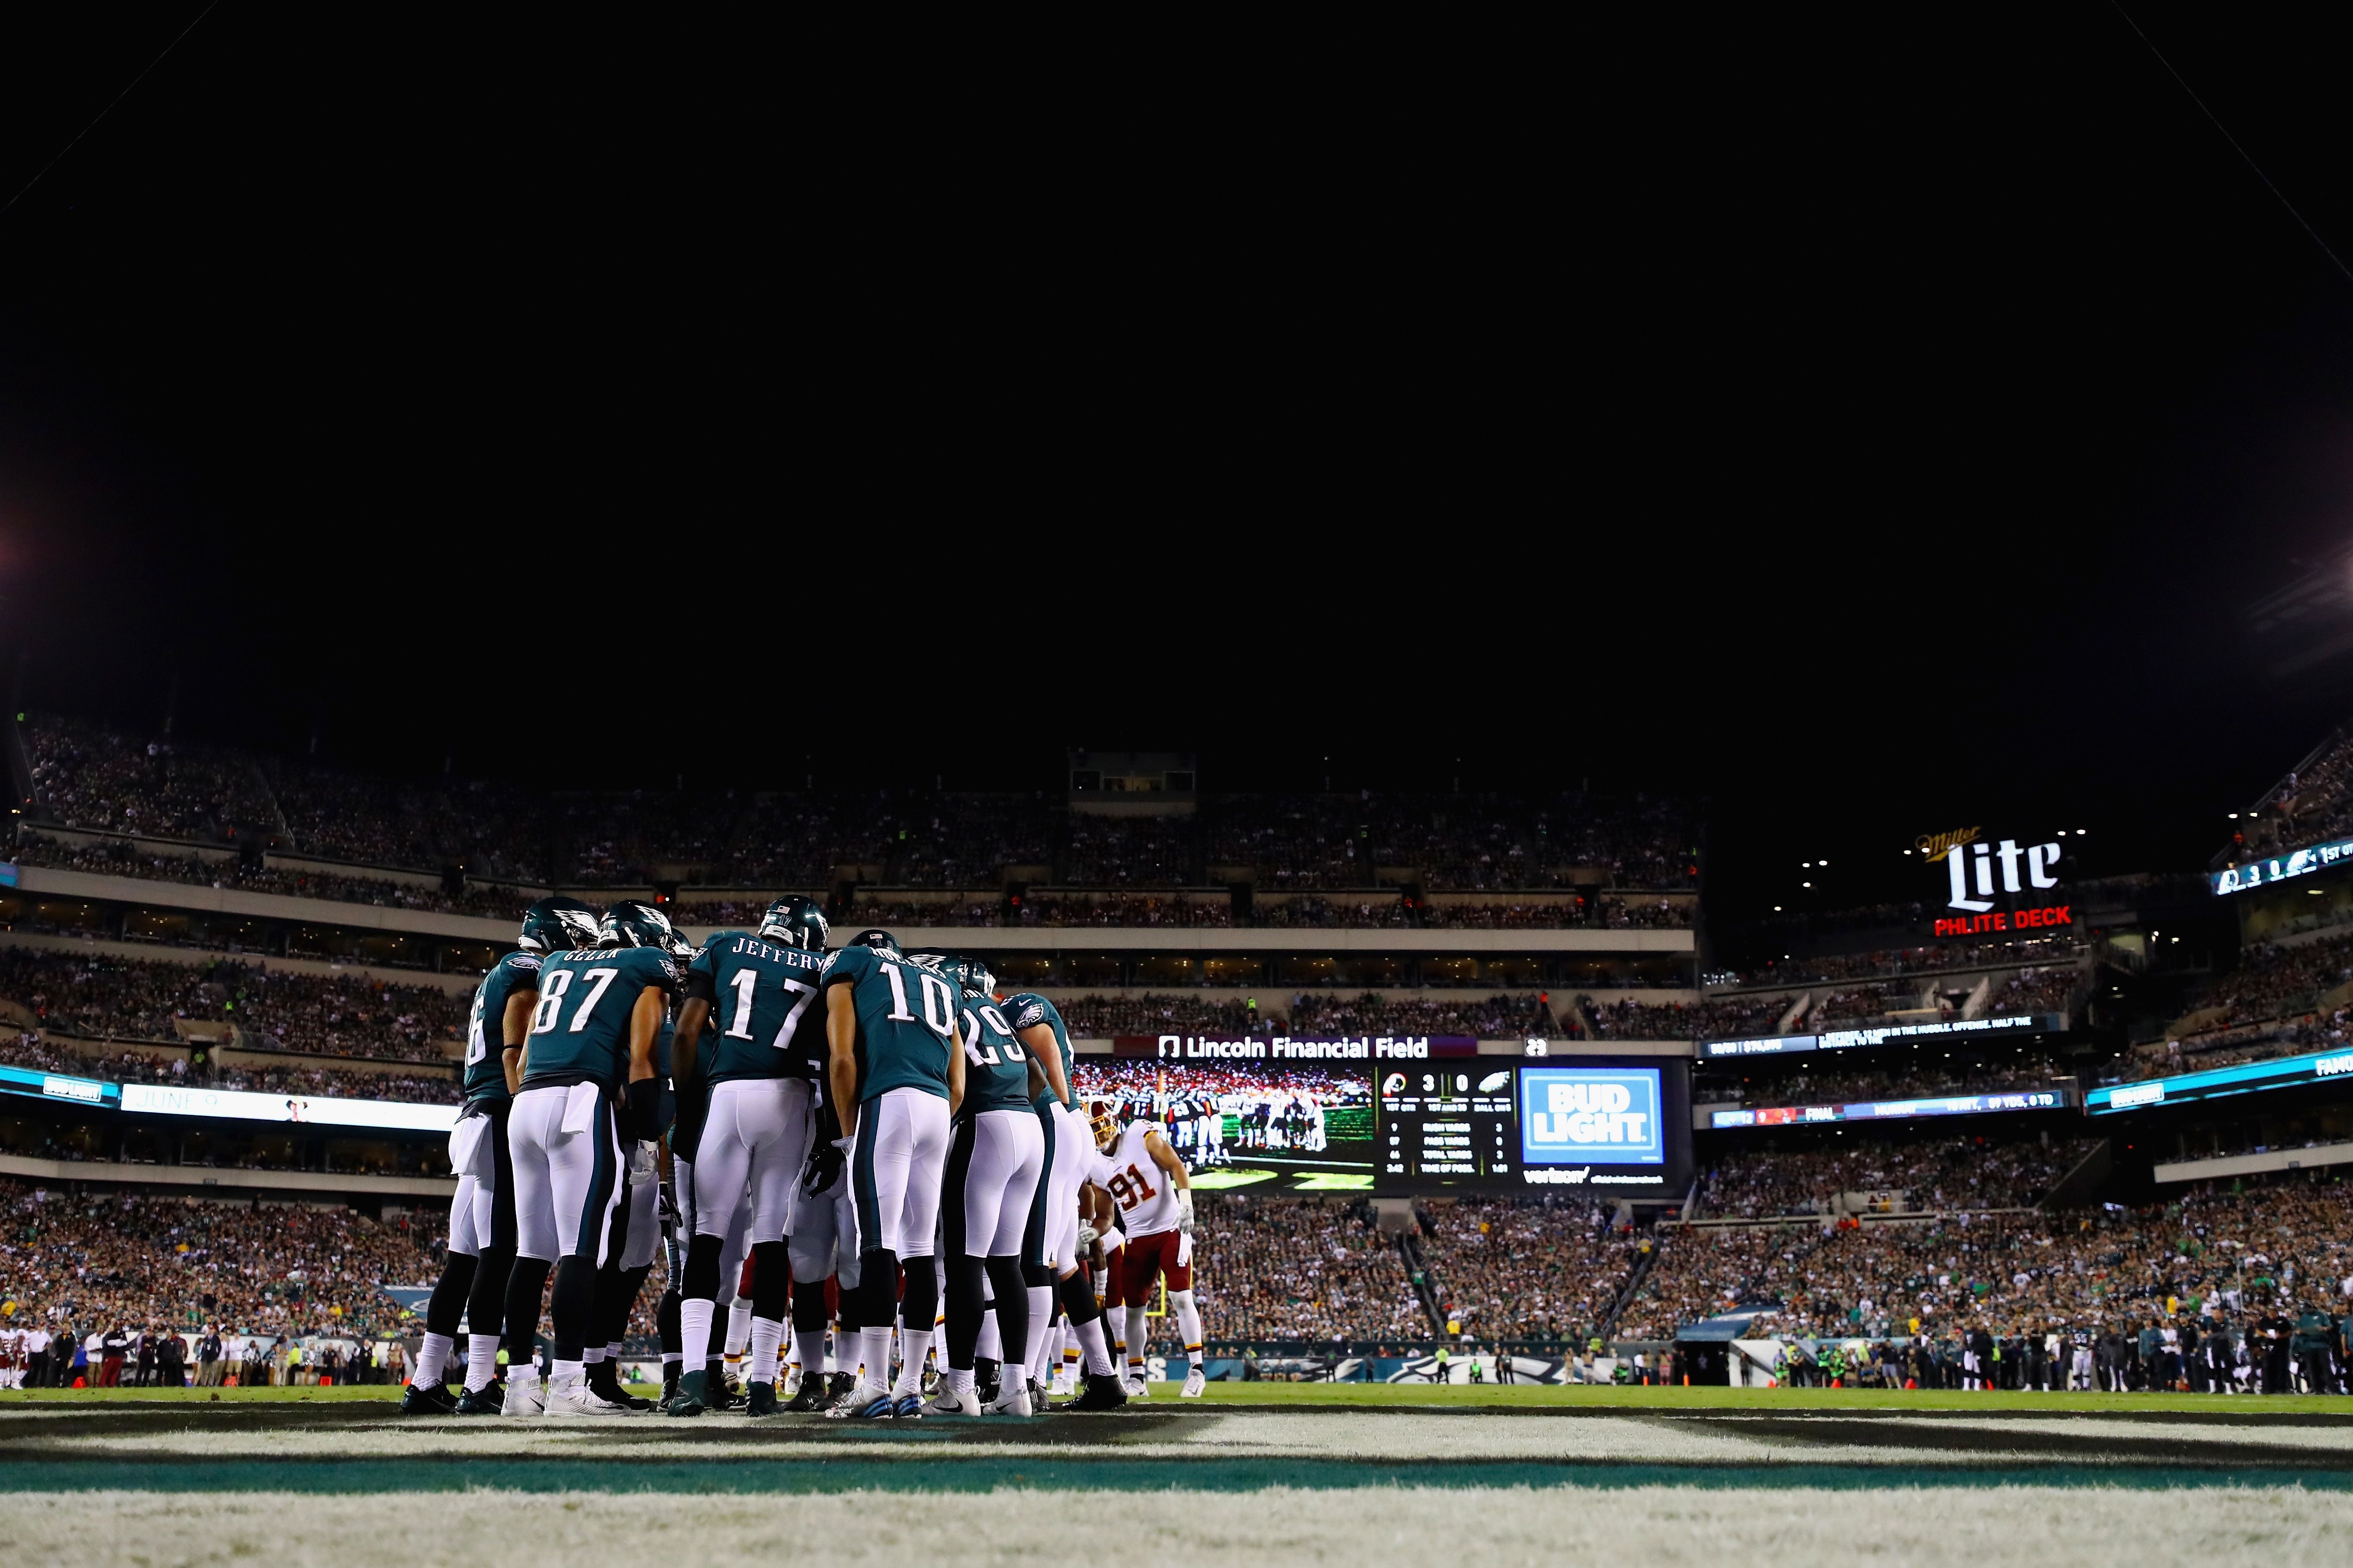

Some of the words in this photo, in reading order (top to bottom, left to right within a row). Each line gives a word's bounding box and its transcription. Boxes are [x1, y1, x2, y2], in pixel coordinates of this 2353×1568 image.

[2320, 847, 2340, 864] 1ST
[1948, 839, 2061, 912] Lite
[2251, 866, 2260, 881] 3
[778, 914, 792, 927] 17
[1934, 912, 2007, 937] PHLITE
[2014, 905, 2072, 929] DECK
[732, 937, 826, 972] JEFFERY
[531, 968, 619, 1035] 87
[724, 968, 818, 1050] 17
[879, 962, 954, 1036] 10
[465, 994, 486, 1071] 6
[964, 1005, 1027, 1067] 29
[1187, 1036, 1266, 1058] Lincoln
[1272, 1036, 1368, 1058] Financial
[1375, 1036, 1428, 1058] Field
[1526, 1039, 1547, 1056] 23
[1423, 1074, 1434, 1091] 3
[1456, 1074, 1468, 1091] 0
[136, 1090, 195, 1109] JUNE
[205, 1094, 218, 1110] 9
[1548, 1084, 1630, 1113] BUD
[2037, 1094, 2054, 1106] TD
[1805, 1107, 1836, 1121] FINAL
[1496, 1123, 1503, 1132] 3
[1107, 1164, 1156, 1211] 91
